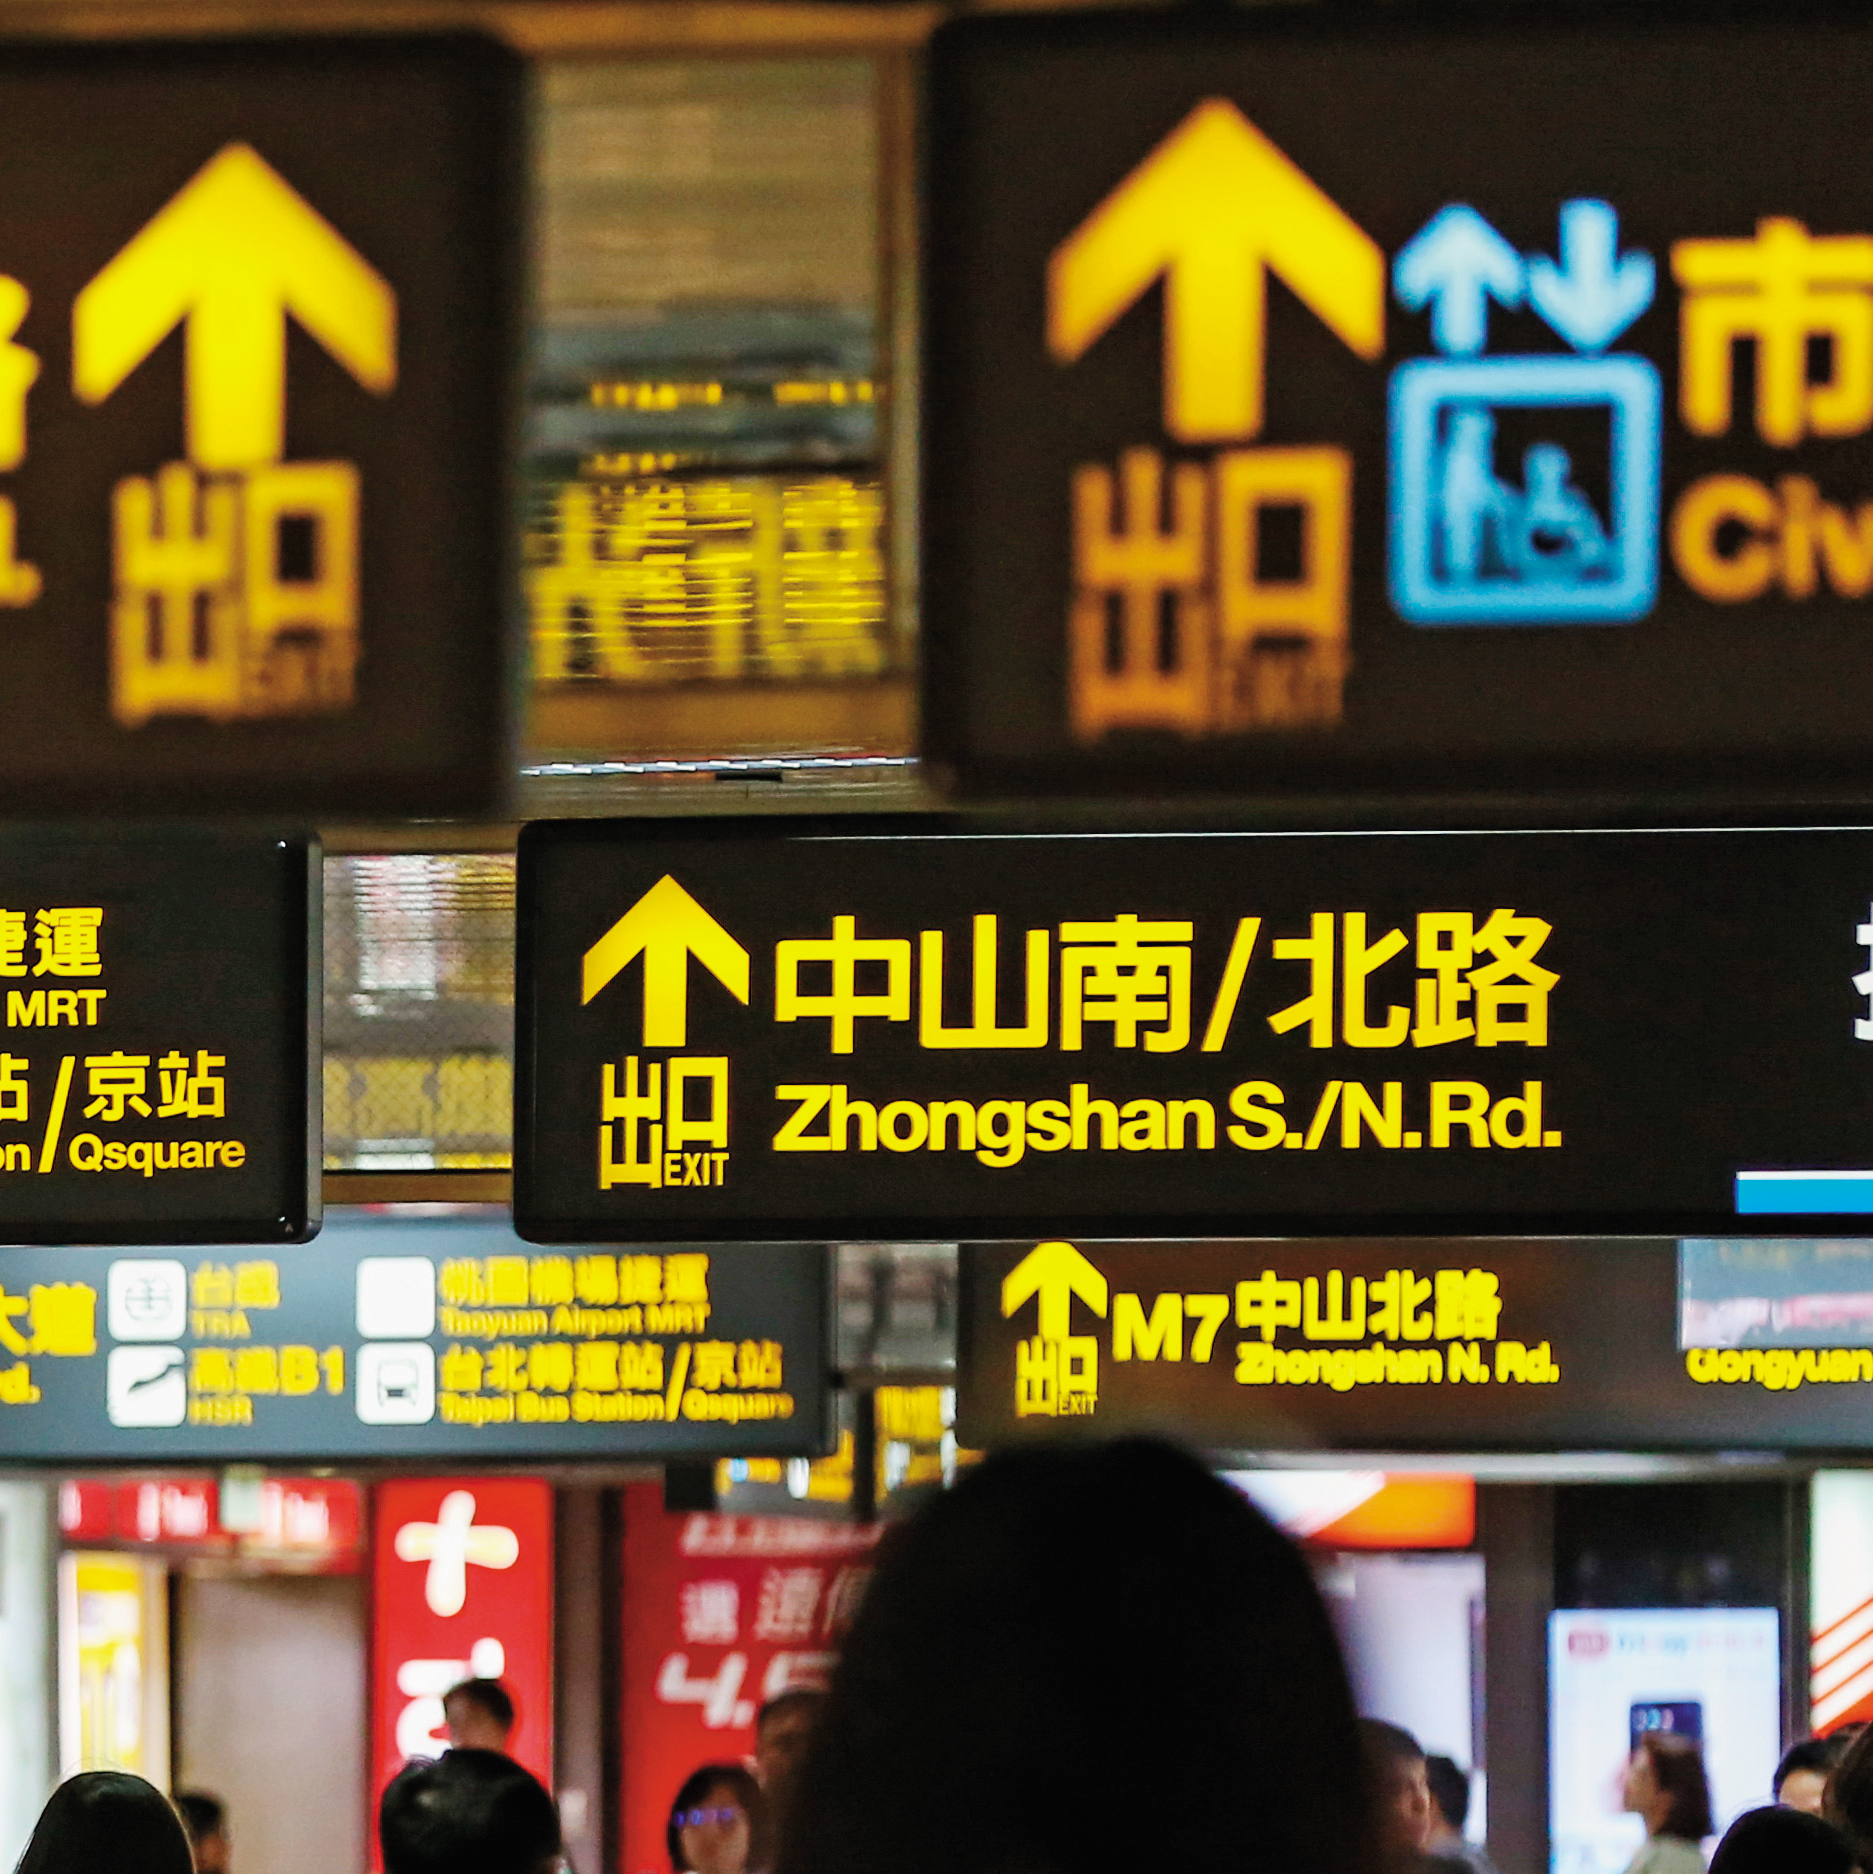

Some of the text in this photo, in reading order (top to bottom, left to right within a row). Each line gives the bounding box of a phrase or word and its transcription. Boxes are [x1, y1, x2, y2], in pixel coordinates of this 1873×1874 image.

[1669, 217, 1873, 445] 市
[110, 459, 361, 726] 出口
[1069, 446, 1352, 740] 出口
[6, 989, 108, 1029] MRT
[773, 907, 1562, 1055] 中山南/北路
[68, 1133, 246, 1178] Qsquare
[599, 1055, 729, 1190] 出口
[771, 1082, 1216, 1168] Zhongshan
[663, 1152, 730, 1189] EXIT
[1111, 1292, 1230, 1363] M7
[1234, 1267, 1503, 1342] 中山北路
[1014, 1334, 1099, 1418] 出口
[1057, 1391, 1099, 1417] EXIT
[1233, 1340, 1560, 1392] Zhongshan N. Rd.
